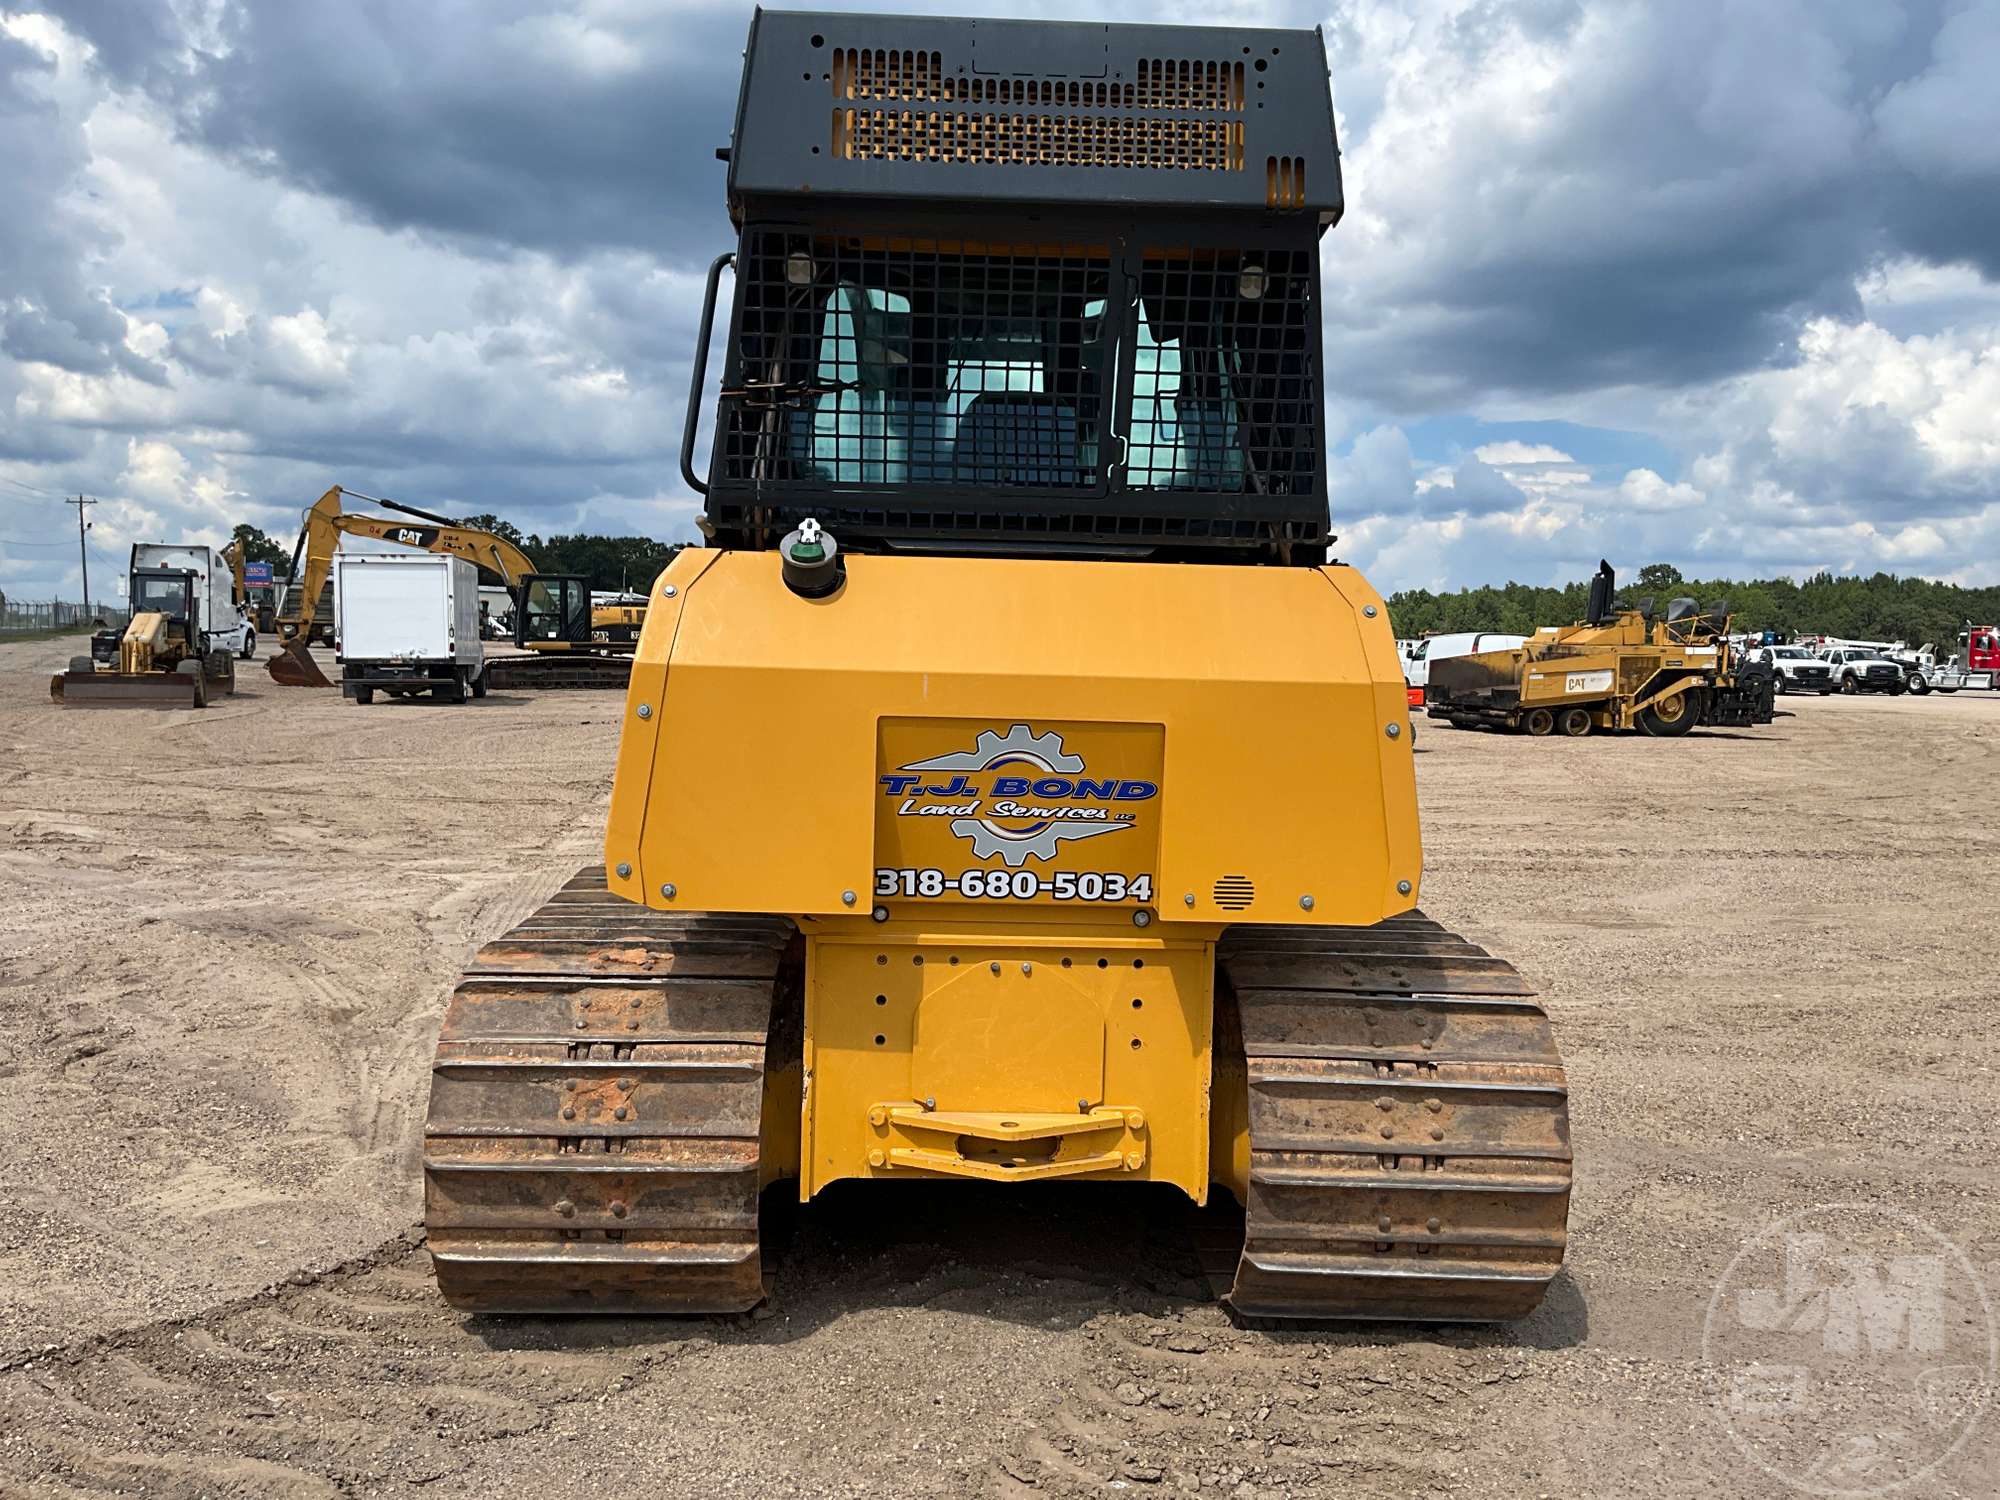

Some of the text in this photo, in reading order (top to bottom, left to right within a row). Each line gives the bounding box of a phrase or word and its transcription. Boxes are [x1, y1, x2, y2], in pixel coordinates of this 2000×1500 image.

[398, 528, 423, 546] CAT
[591, 630, 609, 642] CAT
[1568, 678, 1586, 691] CAT
[878, 775, 1158, 801] T.J. BOND
[897, 799, 981, 816] Land
[987, 801, 1109, 819] Services
[874, 868, 1153, 901] 318-680-5034
